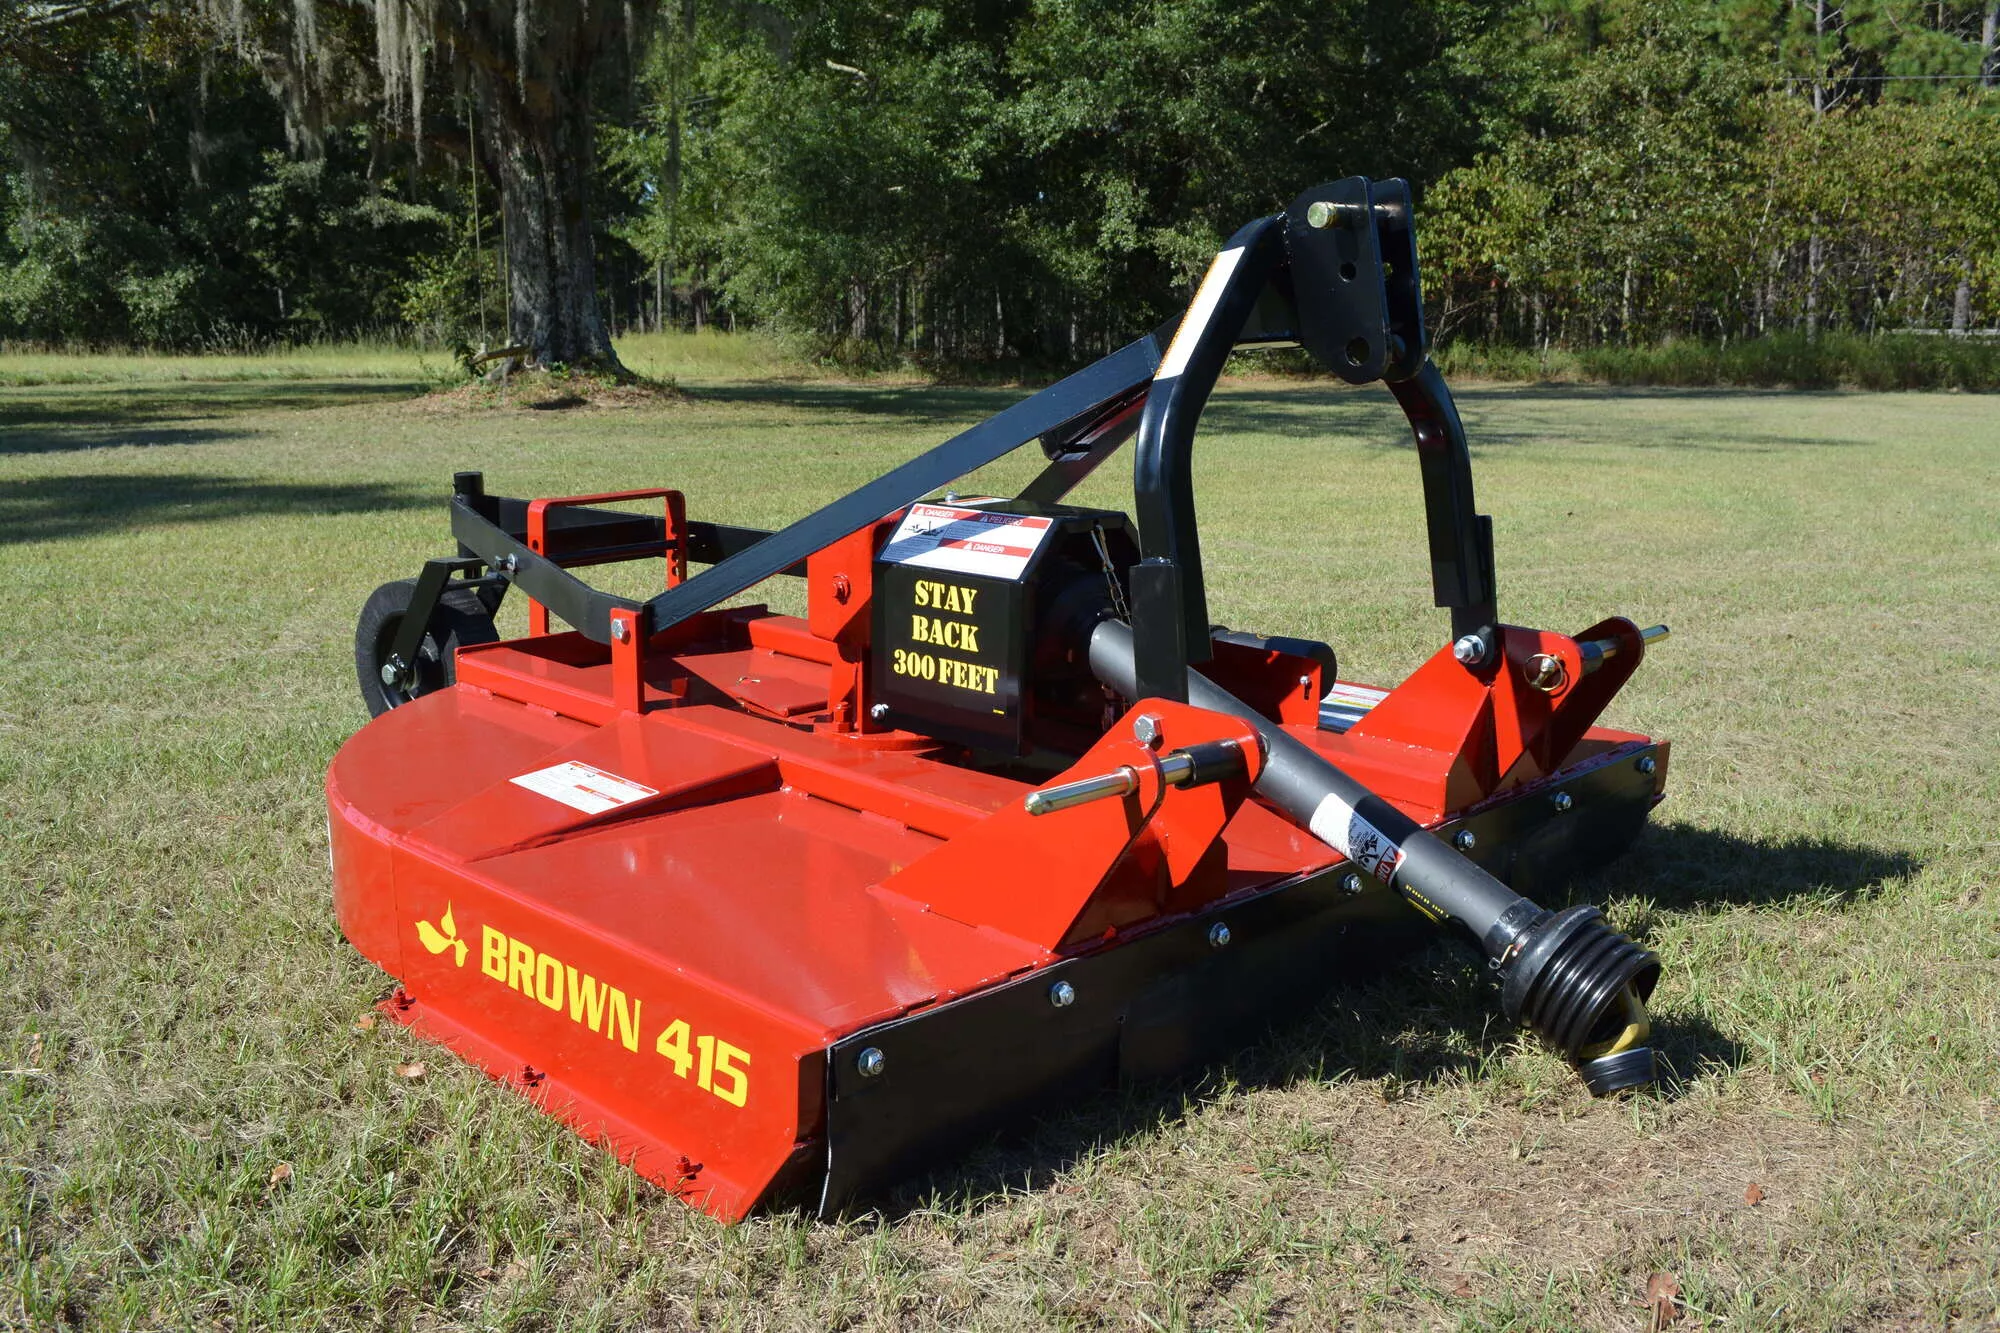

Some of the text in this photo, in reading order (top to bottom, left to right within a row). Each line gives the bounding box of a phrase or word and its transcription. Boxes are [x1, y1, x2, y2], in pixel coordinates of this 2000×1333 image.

[924, 508, 955, 518] DANGER
[973, 543, 1005, 553] DANGER
[915, 579, 977, 614] STAY
[911, 614, 979, 652] BACK
[893, 649, 999, 694] 300 FEET
[481, 924, 751, 1108] BROWN 415
